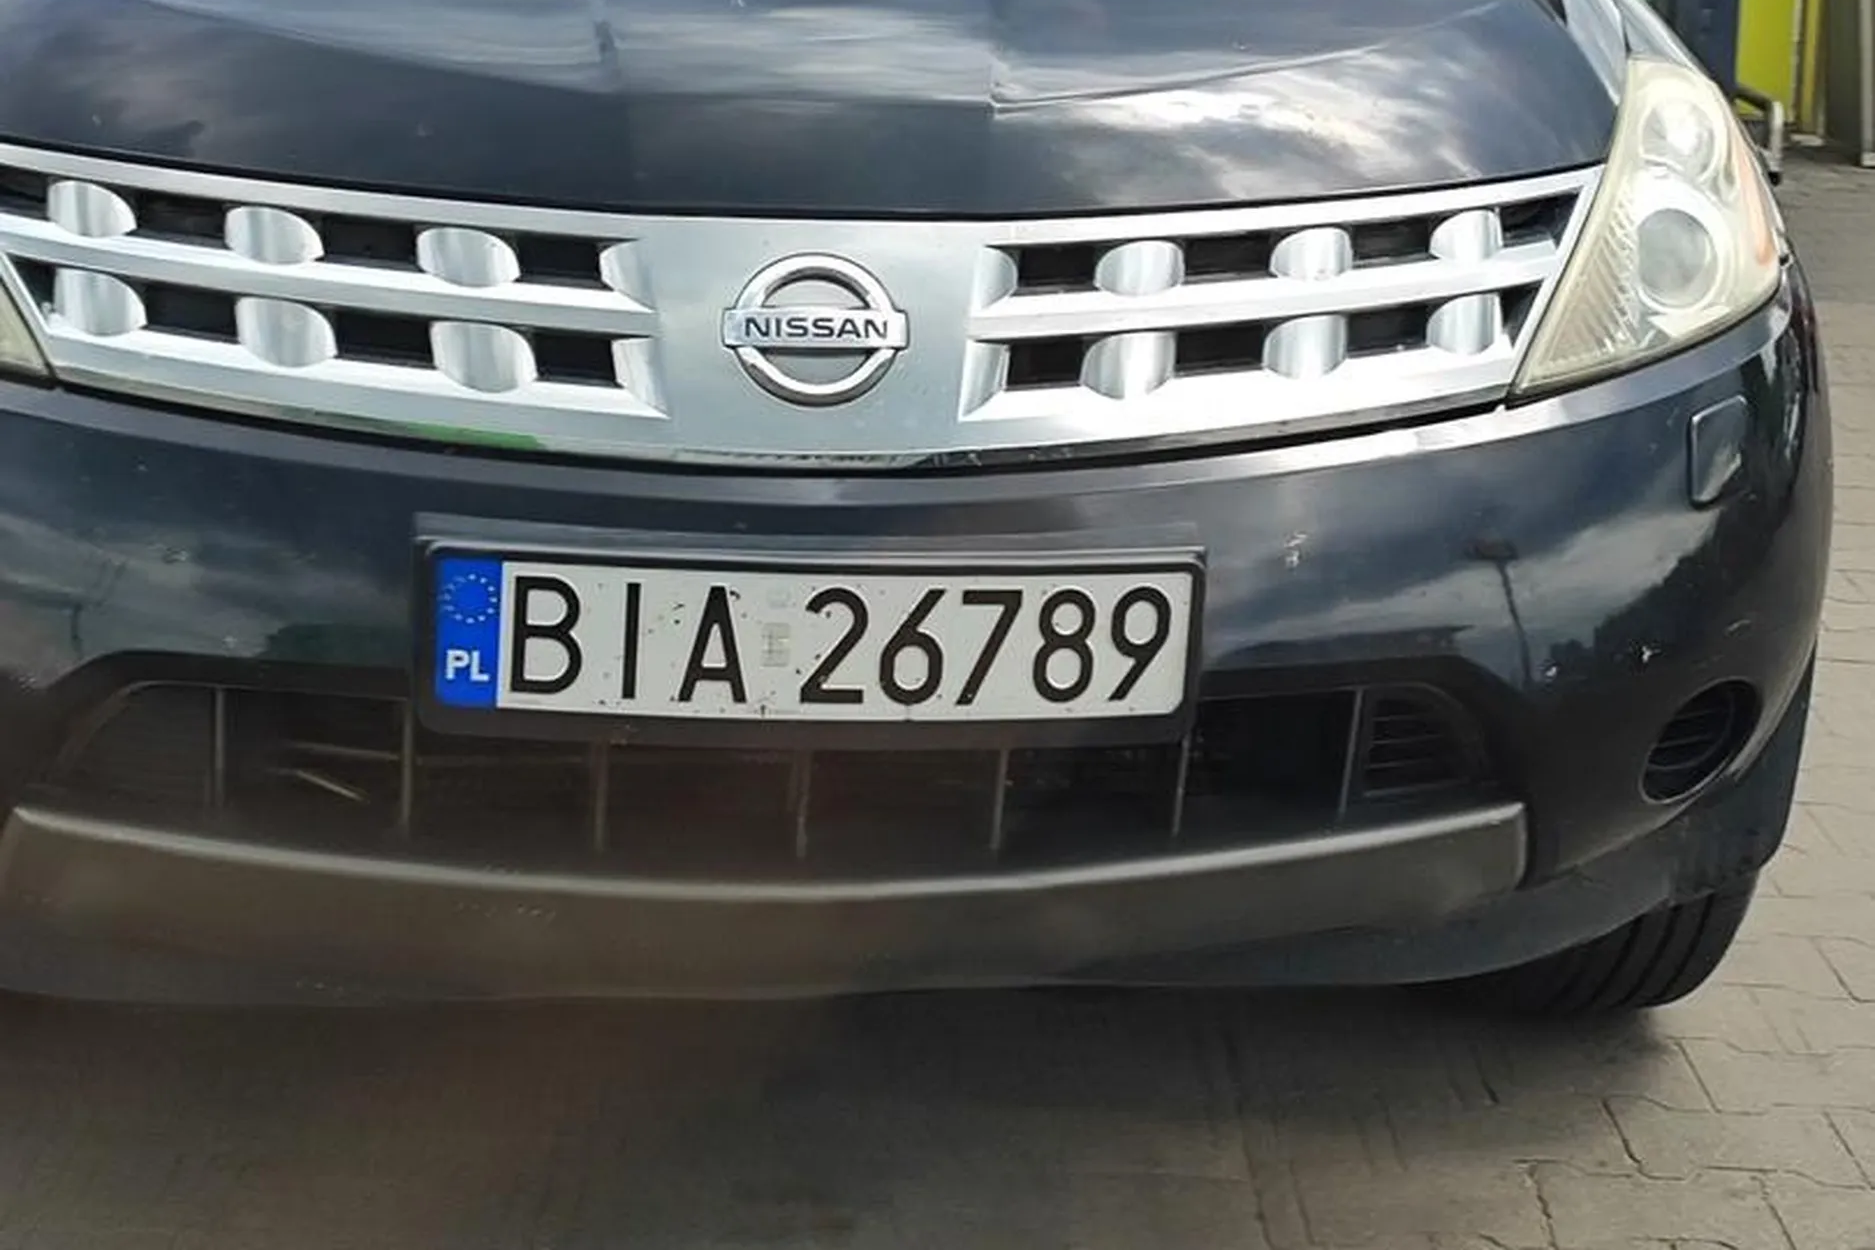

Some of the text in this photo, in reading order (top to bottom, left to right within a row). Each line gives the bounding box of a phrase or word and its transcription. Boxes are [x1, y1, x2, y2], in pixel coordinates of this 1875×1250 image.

[744, 316, 888, 340] NISSAN
[508, 575, 1171, 706] BIA 26789
[444, 648, 489, 682] PL
